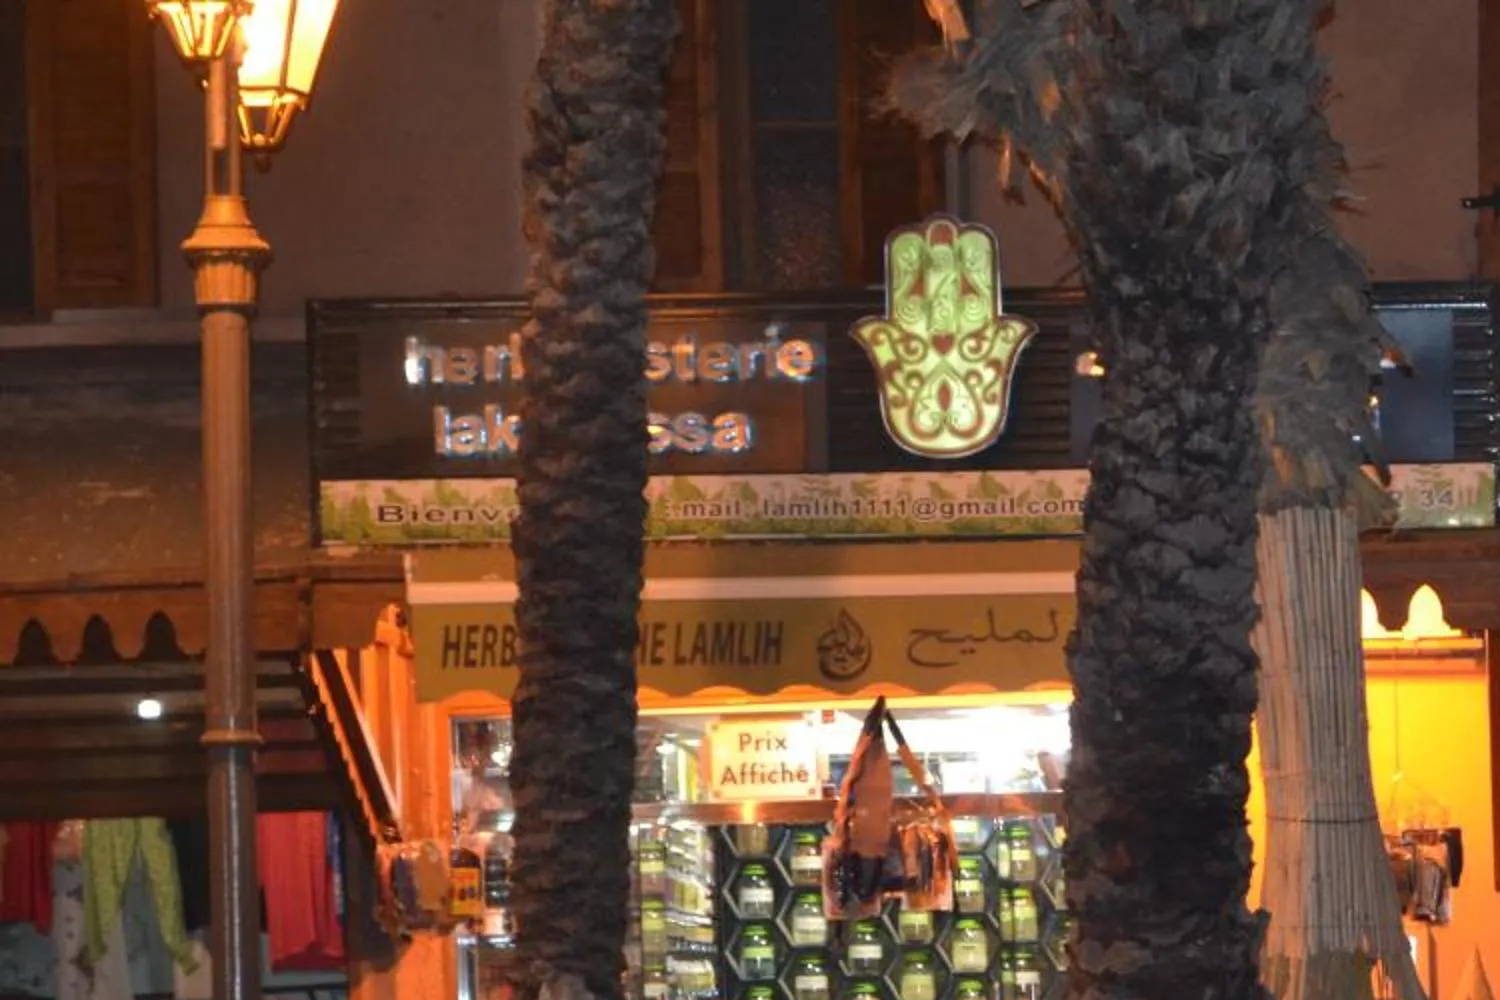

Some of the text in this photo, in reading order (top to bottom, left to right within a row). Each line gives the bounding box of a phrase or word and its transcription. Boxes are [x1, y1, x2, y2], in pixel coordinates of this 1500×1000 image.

[405, 326, 816, 384] hersterie
[433, 403, 753, 454] lakssa
[673, 620, 784, 667] LAMLIH
[738, 730, 788, 751] Prix
